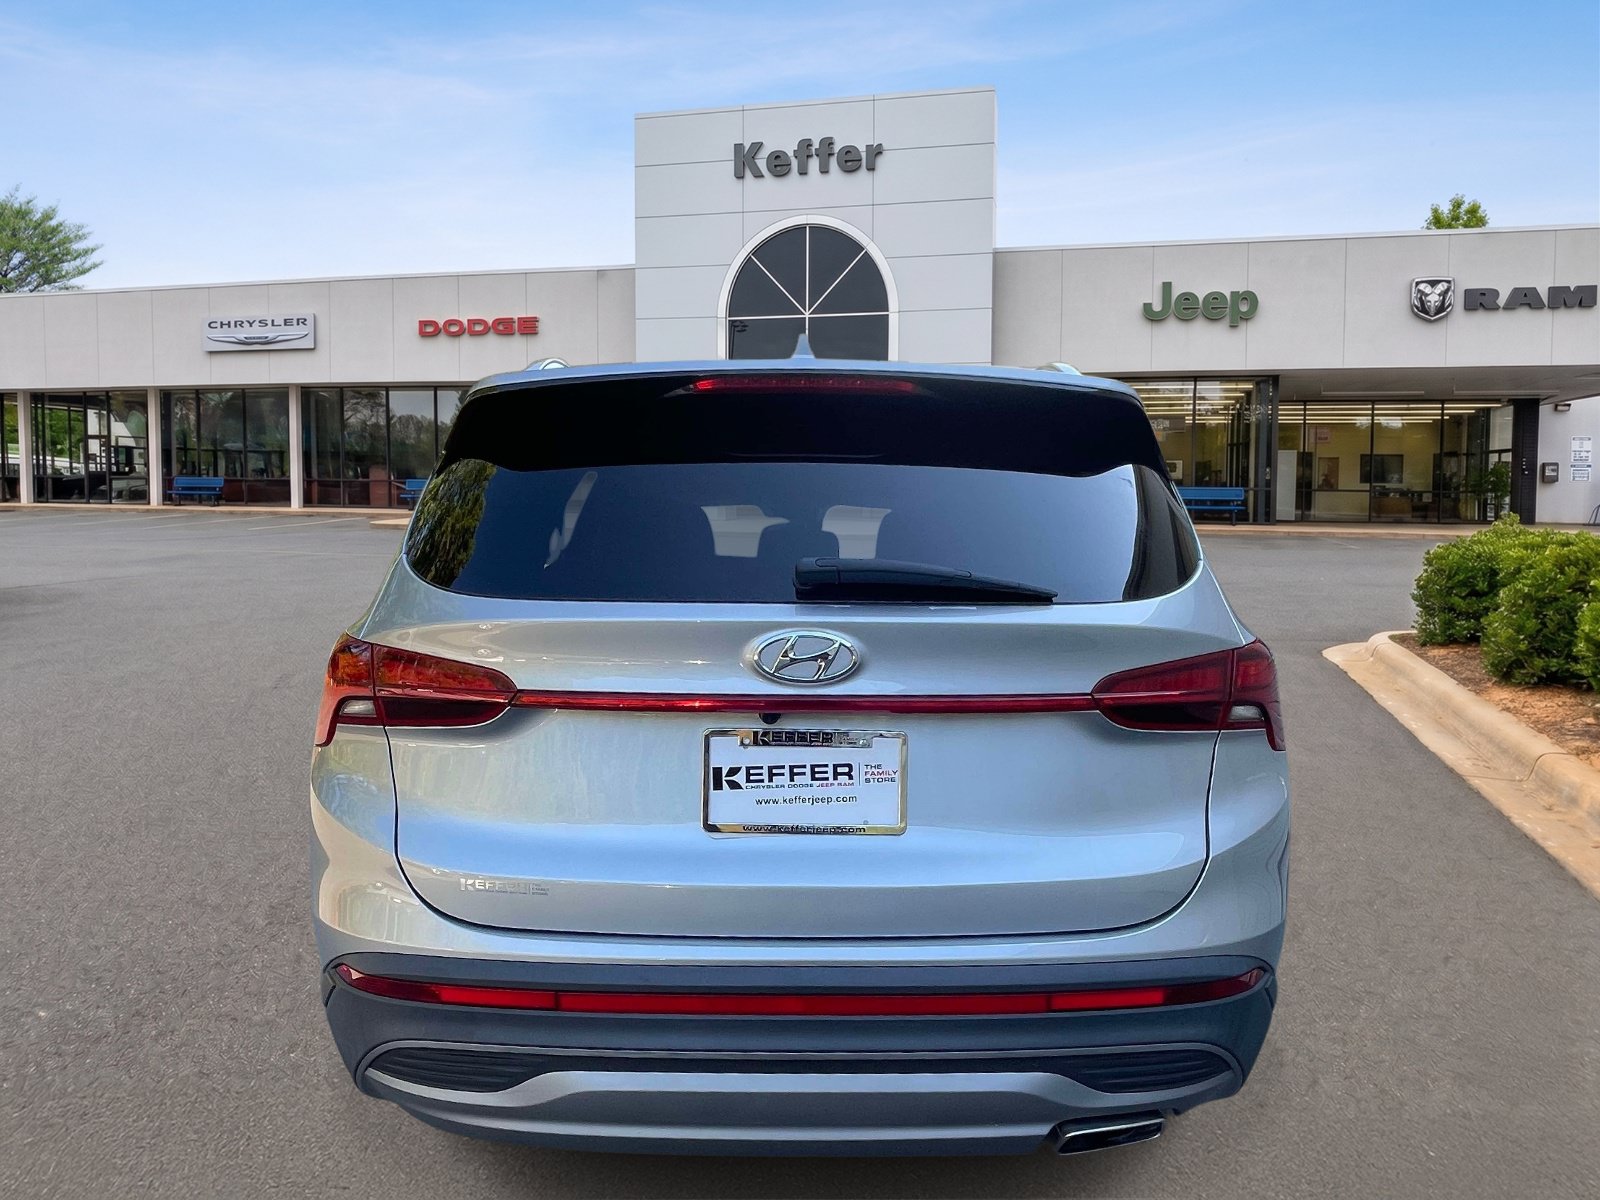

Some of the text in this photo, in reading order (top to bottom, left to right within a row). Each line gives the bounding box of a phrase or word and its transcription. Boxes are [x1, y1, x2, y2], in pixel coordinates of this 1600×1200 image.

[733, 136, 884, 179] Keffer
[1142, 281, 1260, 328] Jeep
[1463, 285, 1599, 311] RAM
[207, 317, 309, 330] CHRYSLER
[417, 316, 540, 338] DODGE
[711, 762, 854, 791] KEFFER
[864, 769, 899, 777] FAMILY
[864, 776, 897, 784] STORE
[755, 795, 858, 806] www.kefferjeep.com
